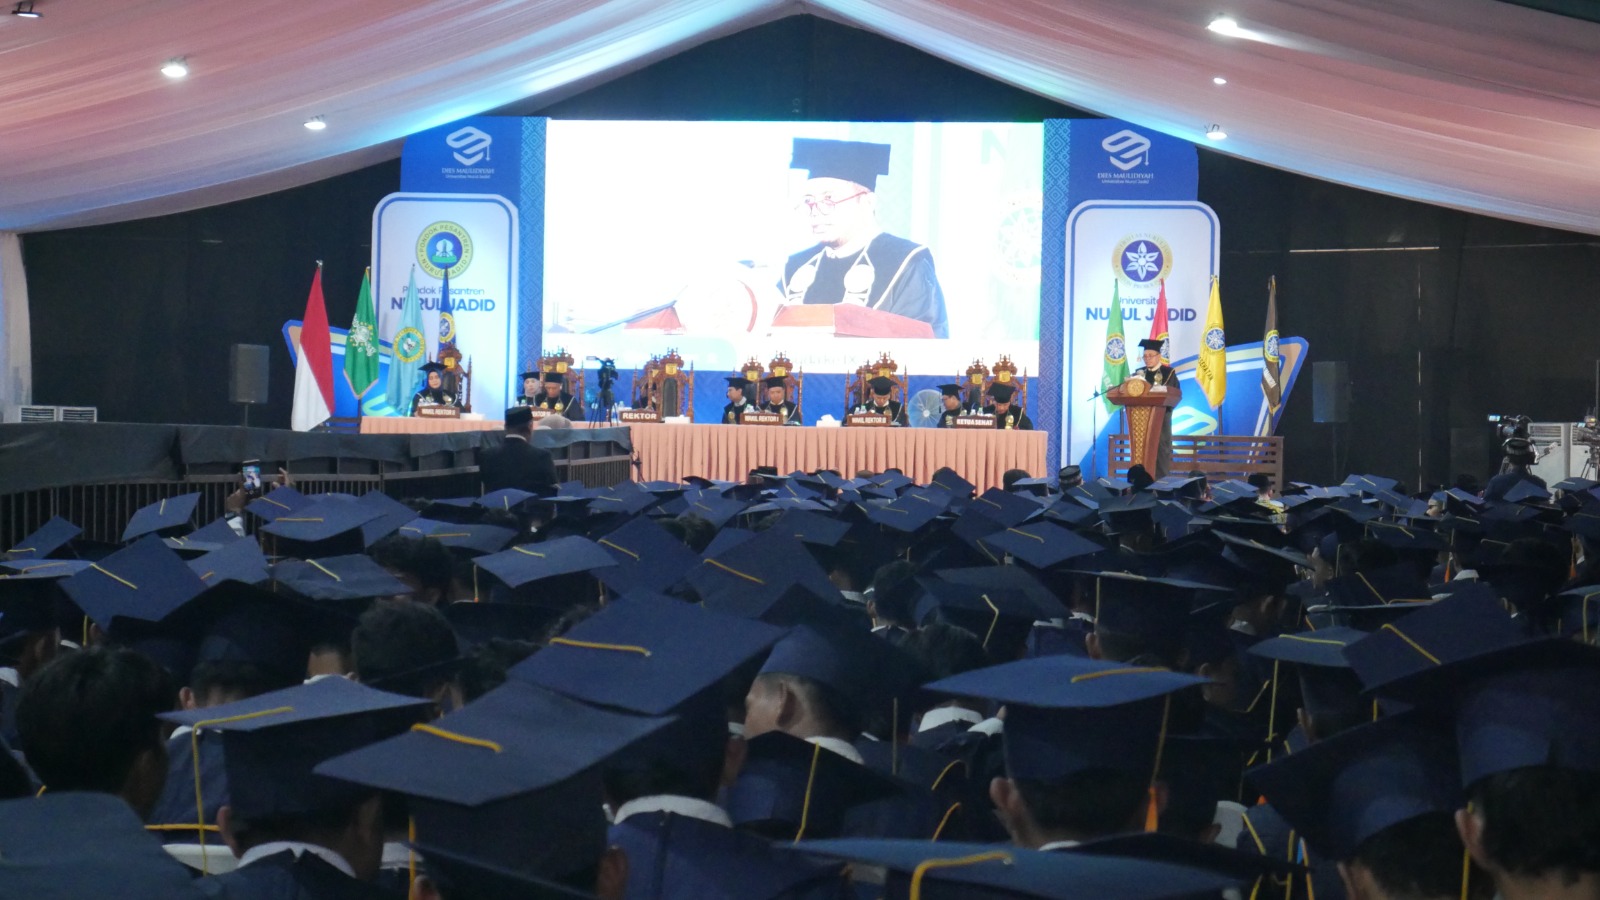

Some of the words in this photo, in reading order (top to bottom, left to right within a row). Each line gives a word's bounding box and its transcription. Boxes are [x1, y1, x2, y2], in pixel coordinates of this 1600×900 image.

[419, 226, 439, 253] PONDOK
[440, 224, 470, 254] PESANTREN
[402, 286, 437, 295] Pndok
[439, 287, 485, 295] Psantren
[391, 297, 442, 311] NRUL
[1118, 296, 1161, 306] niversit
[1085, 307, 1142, 321] NUUL
[1145, 308, 1197, 322] JDID
[622, 412, 657, 420] REKTOR
